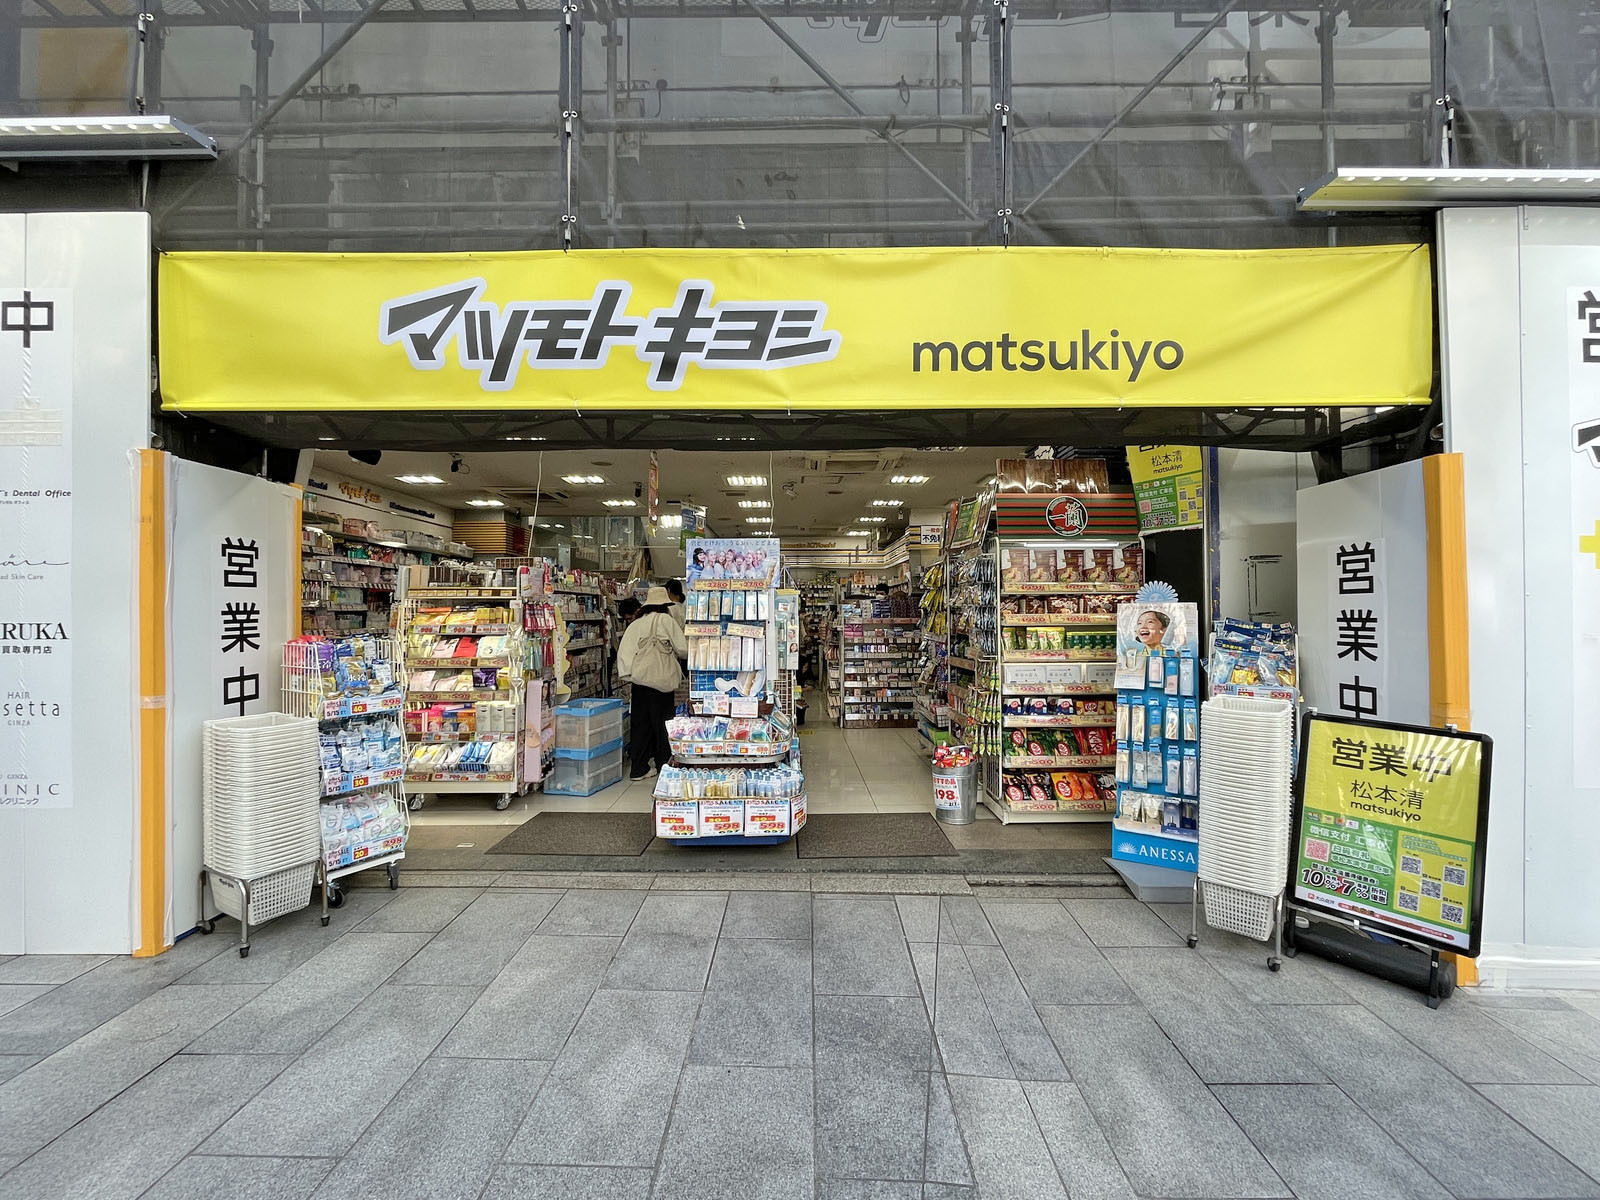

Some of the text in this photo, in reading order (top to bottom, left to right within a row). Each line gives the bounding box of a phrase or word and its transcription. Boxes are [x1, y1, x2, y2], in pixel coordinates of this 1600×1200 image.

[1, 290, 54, 348] 中
[387, 284, 833, 382] マツモトキヨシ
[912, 329, 1184, 382] matsukiyo
[1153, 463, 1183, 474] matsukiyo
[12, 489, 40, 497] Dental
[45, 489, 72, 498] Office
[221, 537, 260, 716] 営業中
[1336, 541, 1379, 719] 営業中
[8, 691, 30, 699] HAIR
[1332, 737, 1452, 783] 営業中
[1350, 779, 1424, 810] 松本清
[1350, 801, 1421, 822] matsukiyo
[1139, 845, 1195, 864] ANESSA
